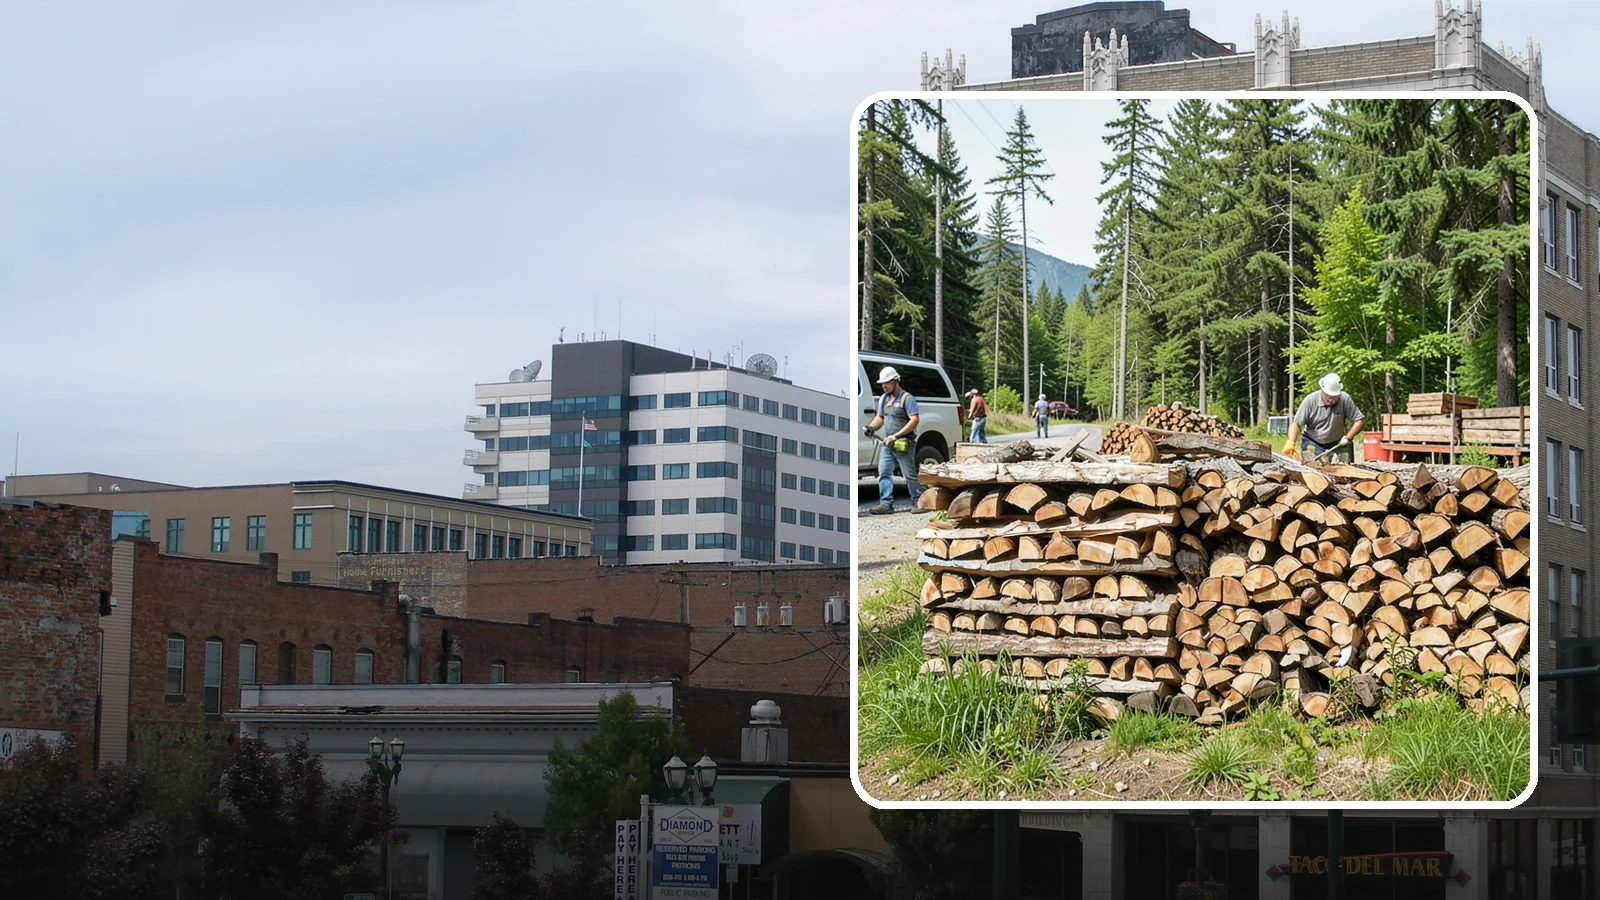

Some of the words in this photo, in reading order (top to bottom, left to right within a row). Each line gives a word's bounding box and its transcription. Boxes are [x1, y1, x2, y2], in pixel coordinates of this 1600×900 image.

[343, 568, 367, 577] Home
[370, 566, 427, 577] Furnishers
[660, 818, 713, 833] DIAMOND
[1022, 815, 1070, 828] BUILDING
[629, 825, 637, 852] PAY
[656, 845, 688, 853] RESERVED
[671, 862, 701, 870] PATRONS
[1346, 856, 1385, 876] DEL
[1392, 857, 1442, 877] MAR
[617, 856, 625, 893] HERE
[628, 856, 637, 893] HERE
[660, 888, 682, 897] PUBLIC
[683, 889, 710, 898] PARKING
